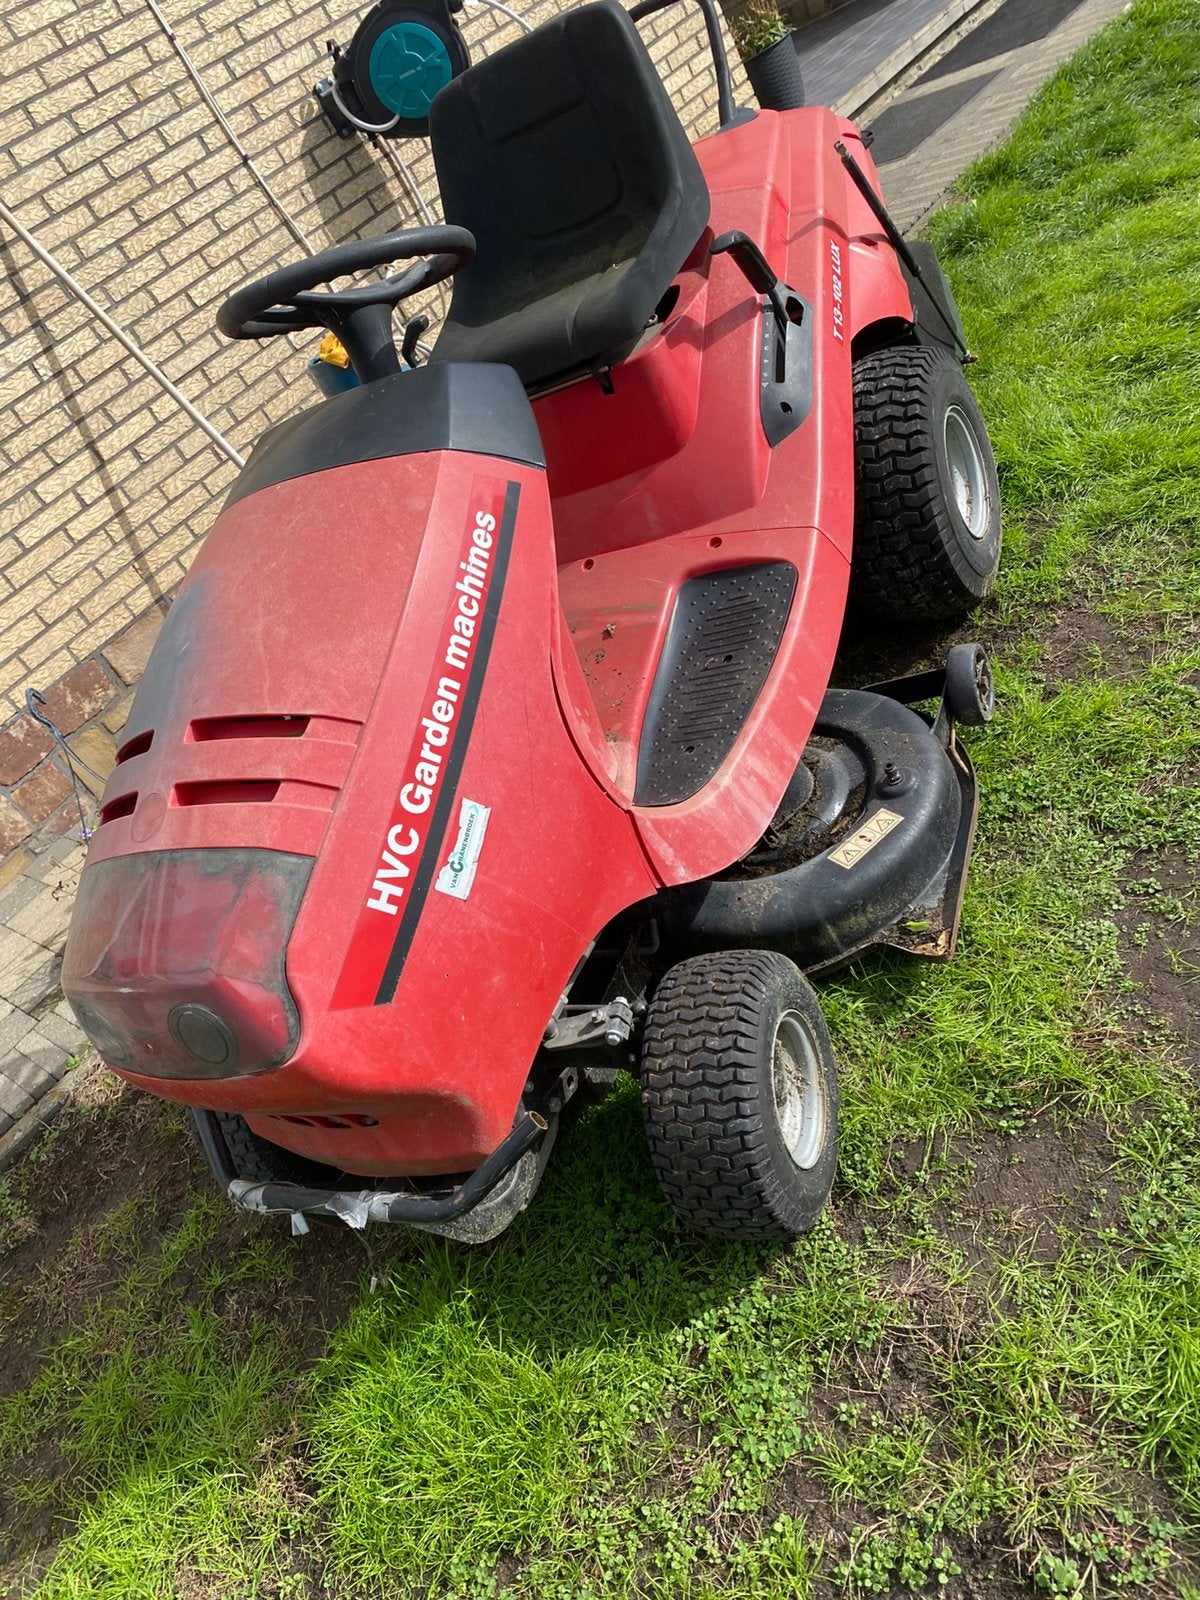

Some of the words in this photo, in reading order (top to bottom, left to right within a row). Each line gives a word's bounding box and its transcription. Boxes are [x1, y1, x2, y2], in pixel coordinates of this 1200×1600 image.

[830, 239, 841, 276] LUX
[832, 275, 843, 326] 13-102
[833, 326, 843, 340] T
[366, 824, 420, 915] HVC
[399, 676, 462, 815] Garden
[445, 510, 496, 670] machines
